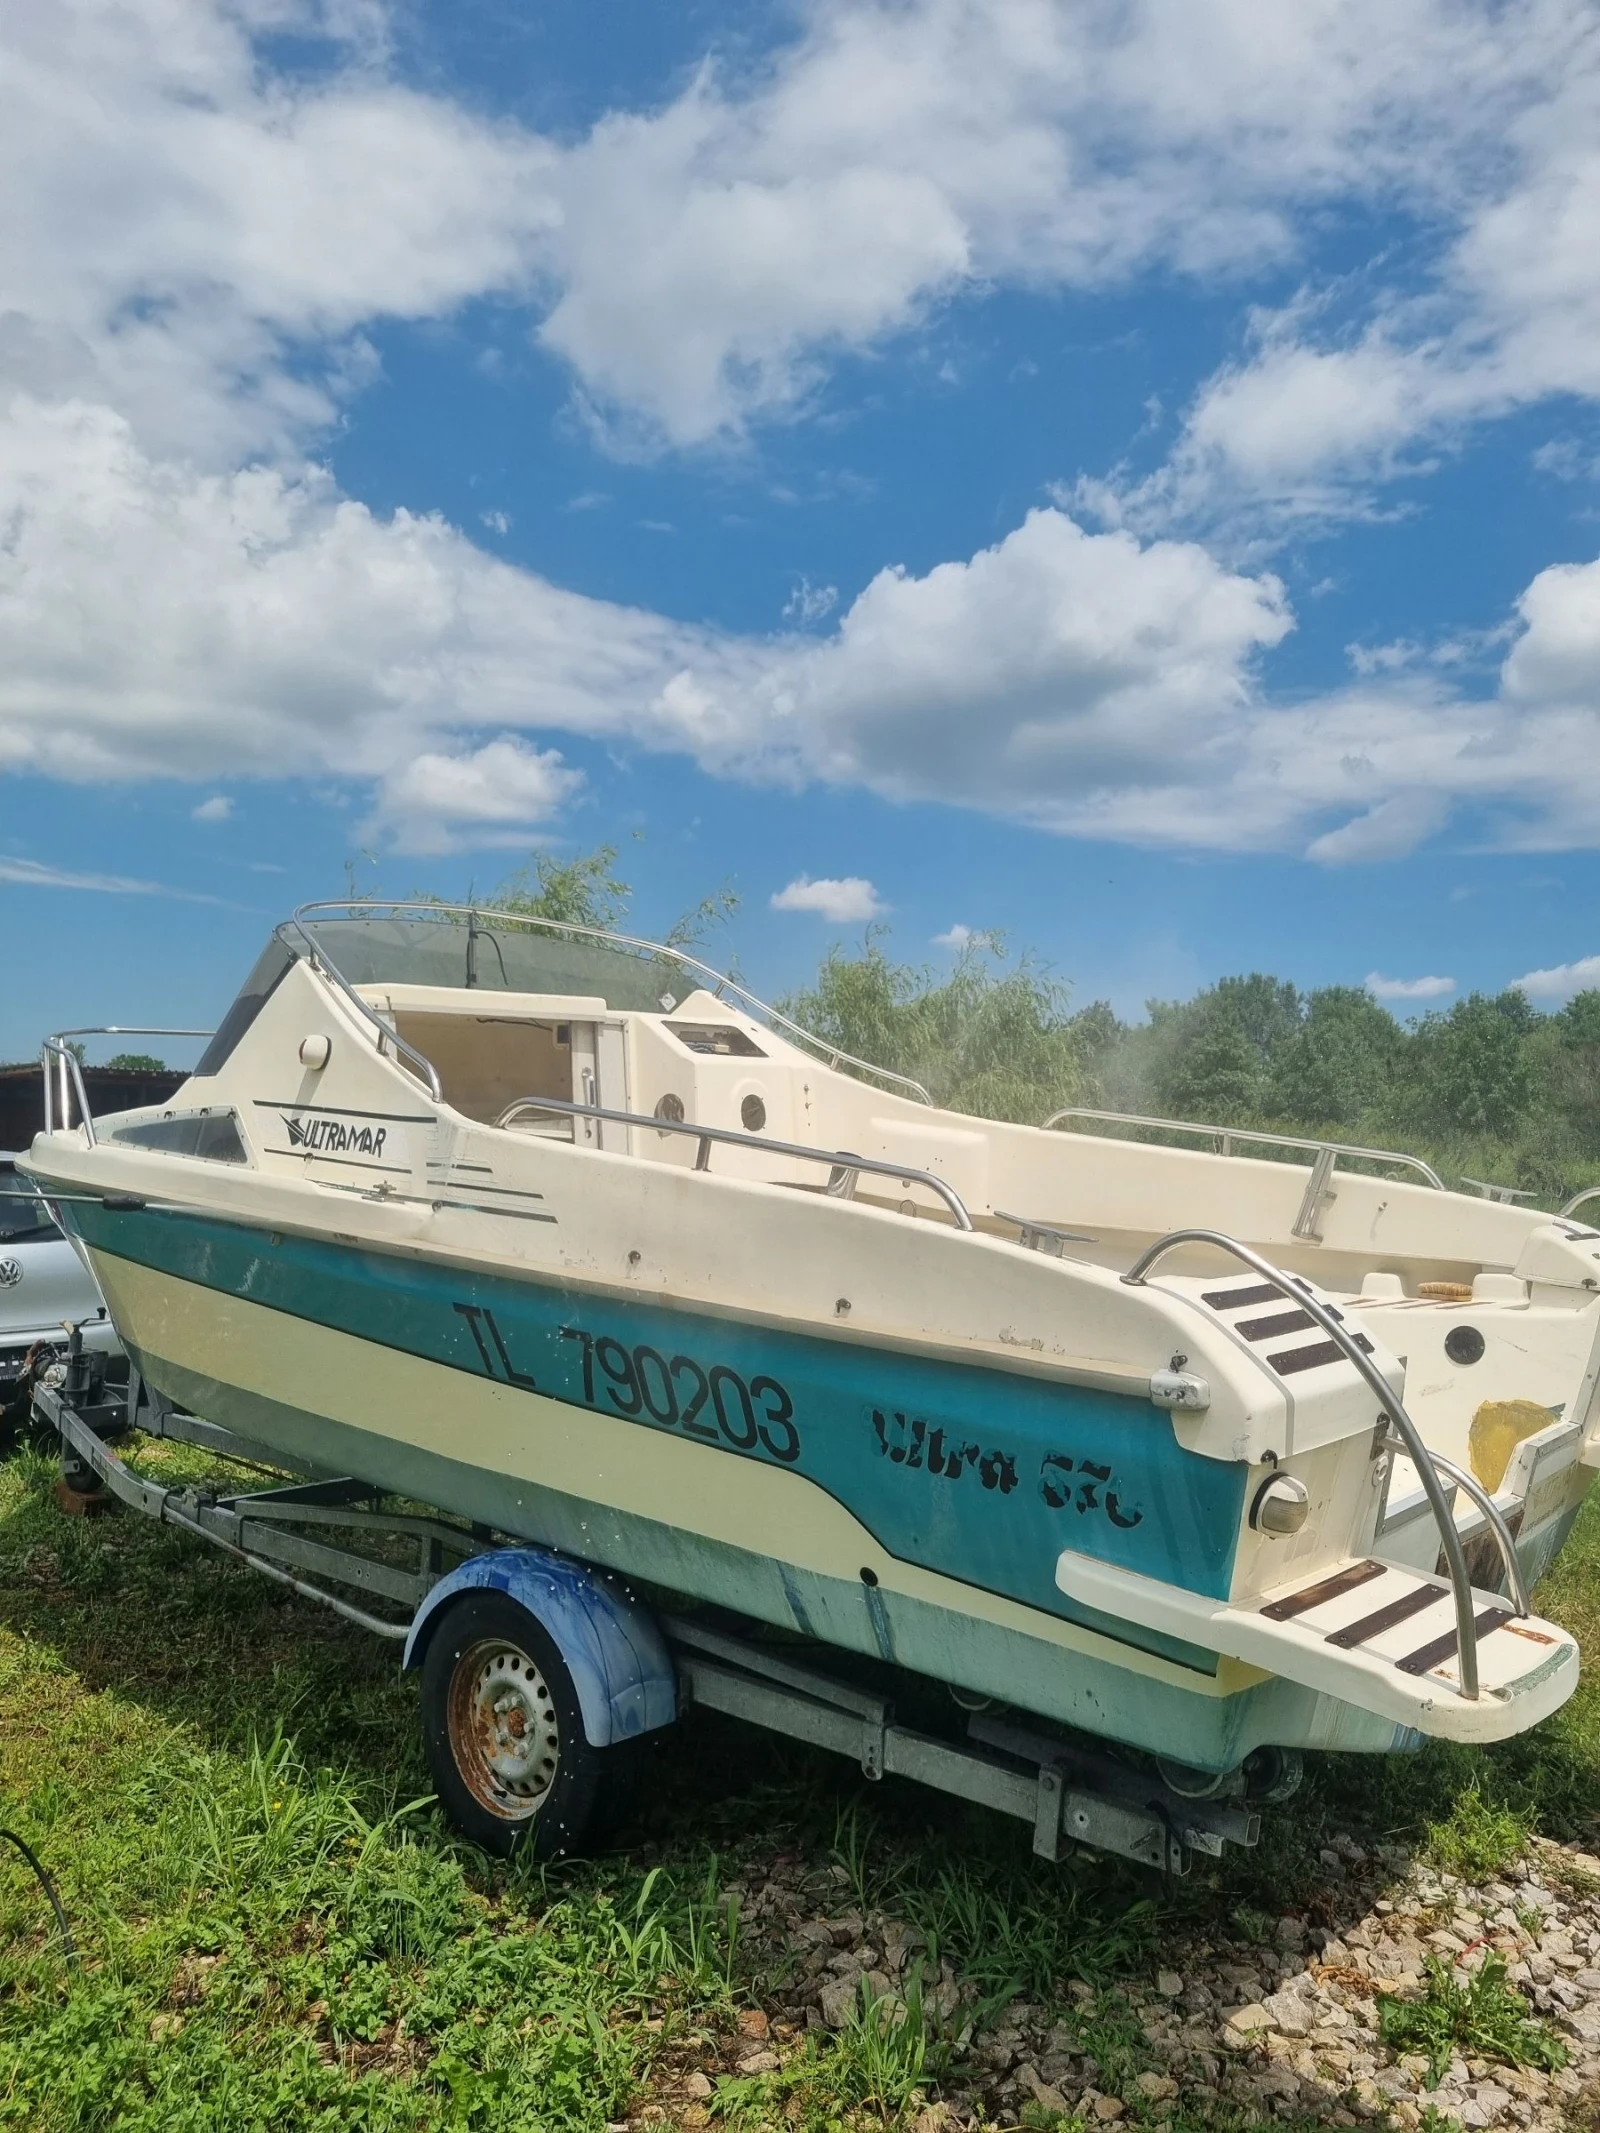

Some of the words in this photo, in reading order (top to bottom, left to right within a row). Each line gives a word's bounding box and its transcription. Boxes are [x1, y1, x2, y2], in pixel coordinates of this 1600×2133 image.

[303, 1118, 387, 1159] ULTRAMAR
[452, 1301, 536, 1387] TL
[558, 1324, 800, 1463] 790203
